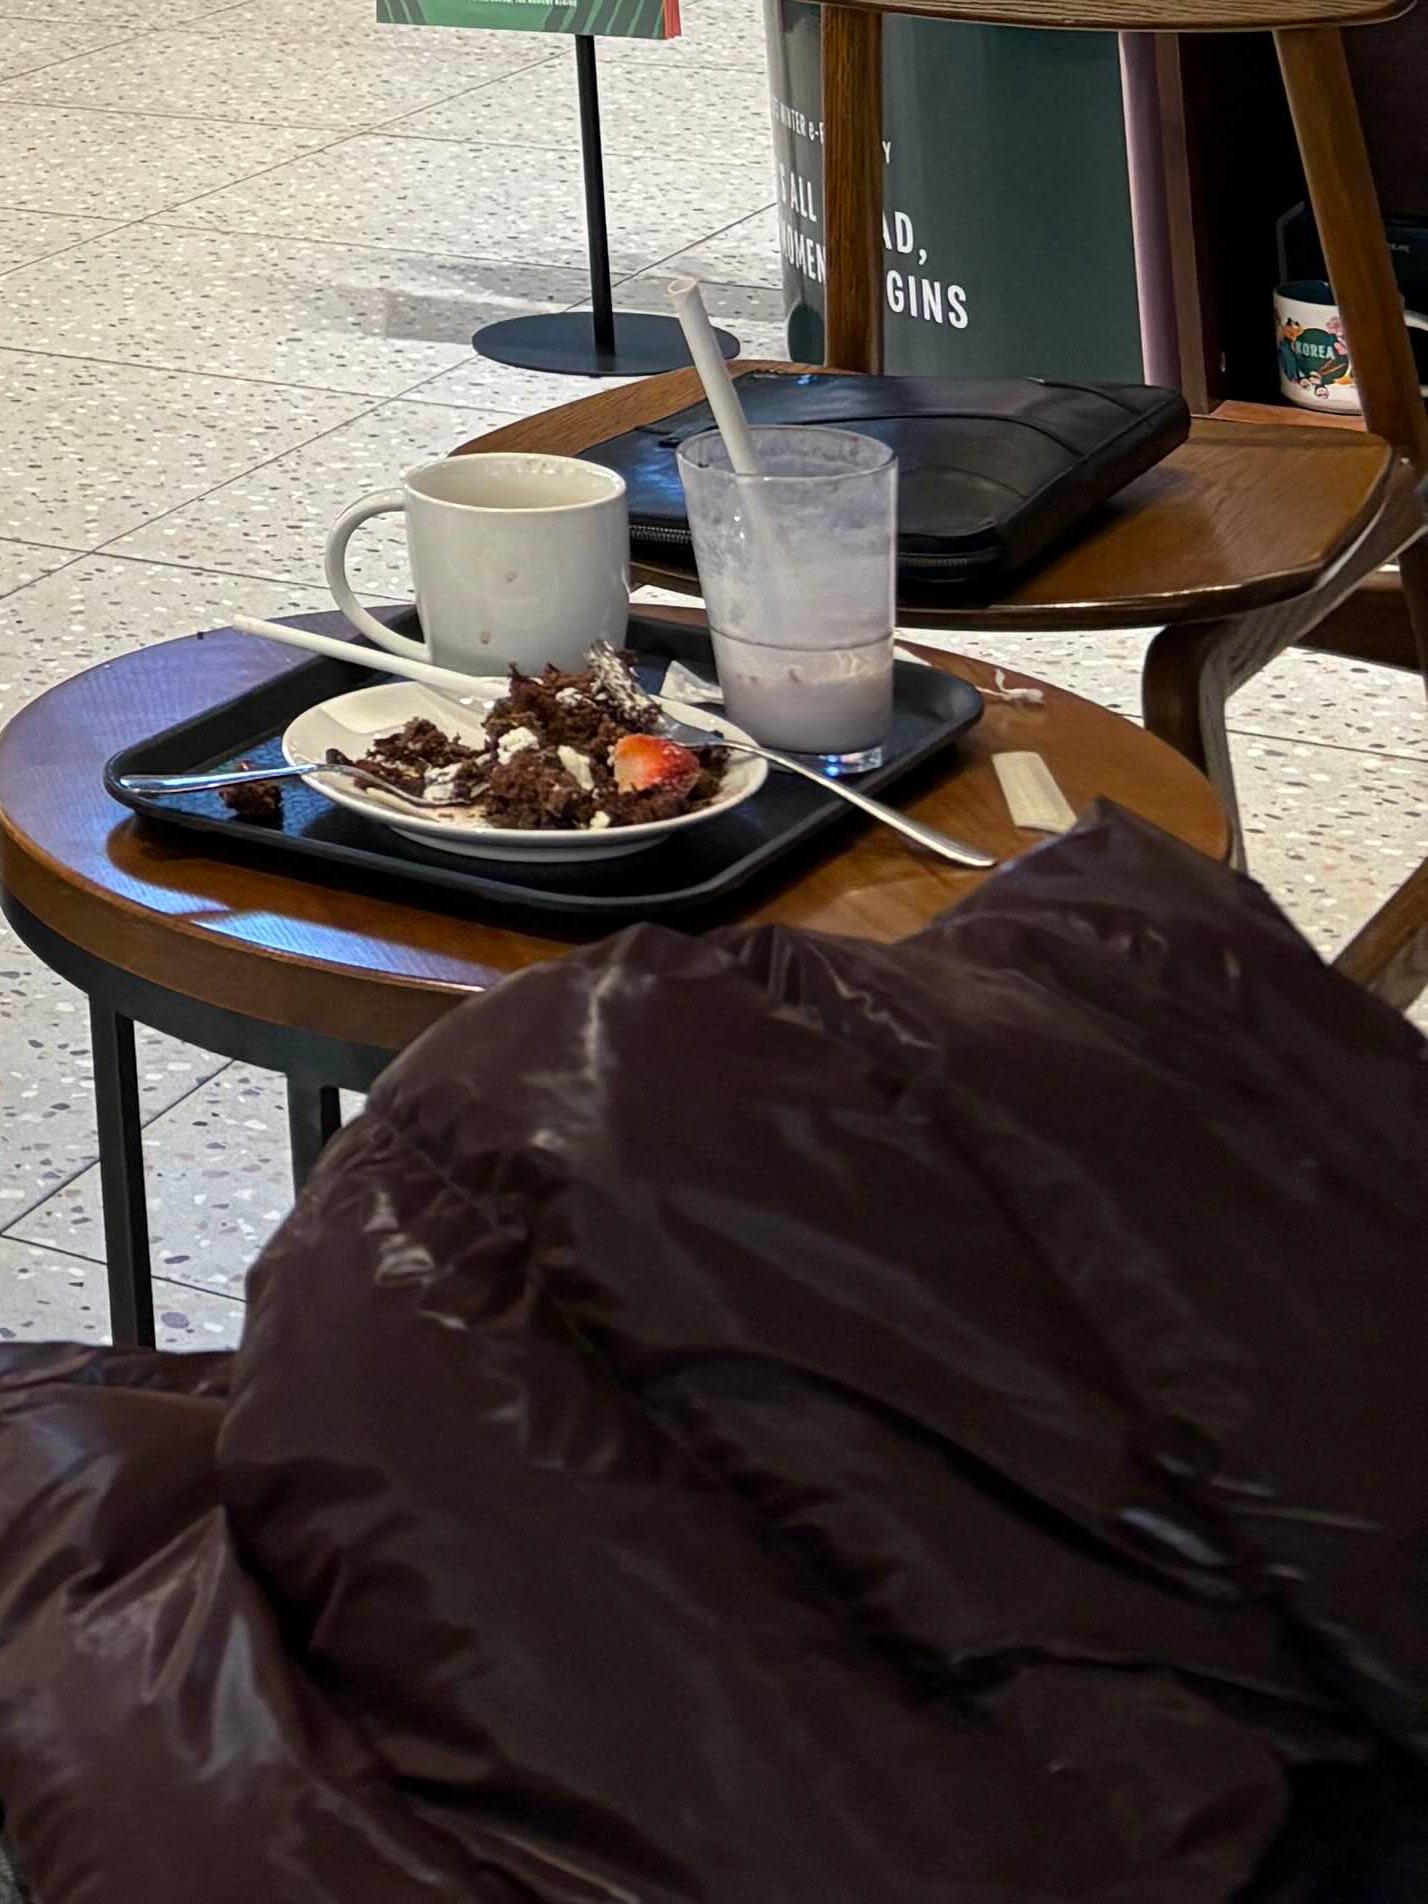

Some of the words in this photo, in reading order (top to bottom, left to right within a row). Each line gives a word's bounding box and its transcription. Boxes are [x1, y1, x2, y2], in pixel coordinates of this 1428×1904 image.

[791, 171, 816, 222] ALL
[886, 270, 968, 329] GINS
[1296, 342, 1335, 359] KOREA
